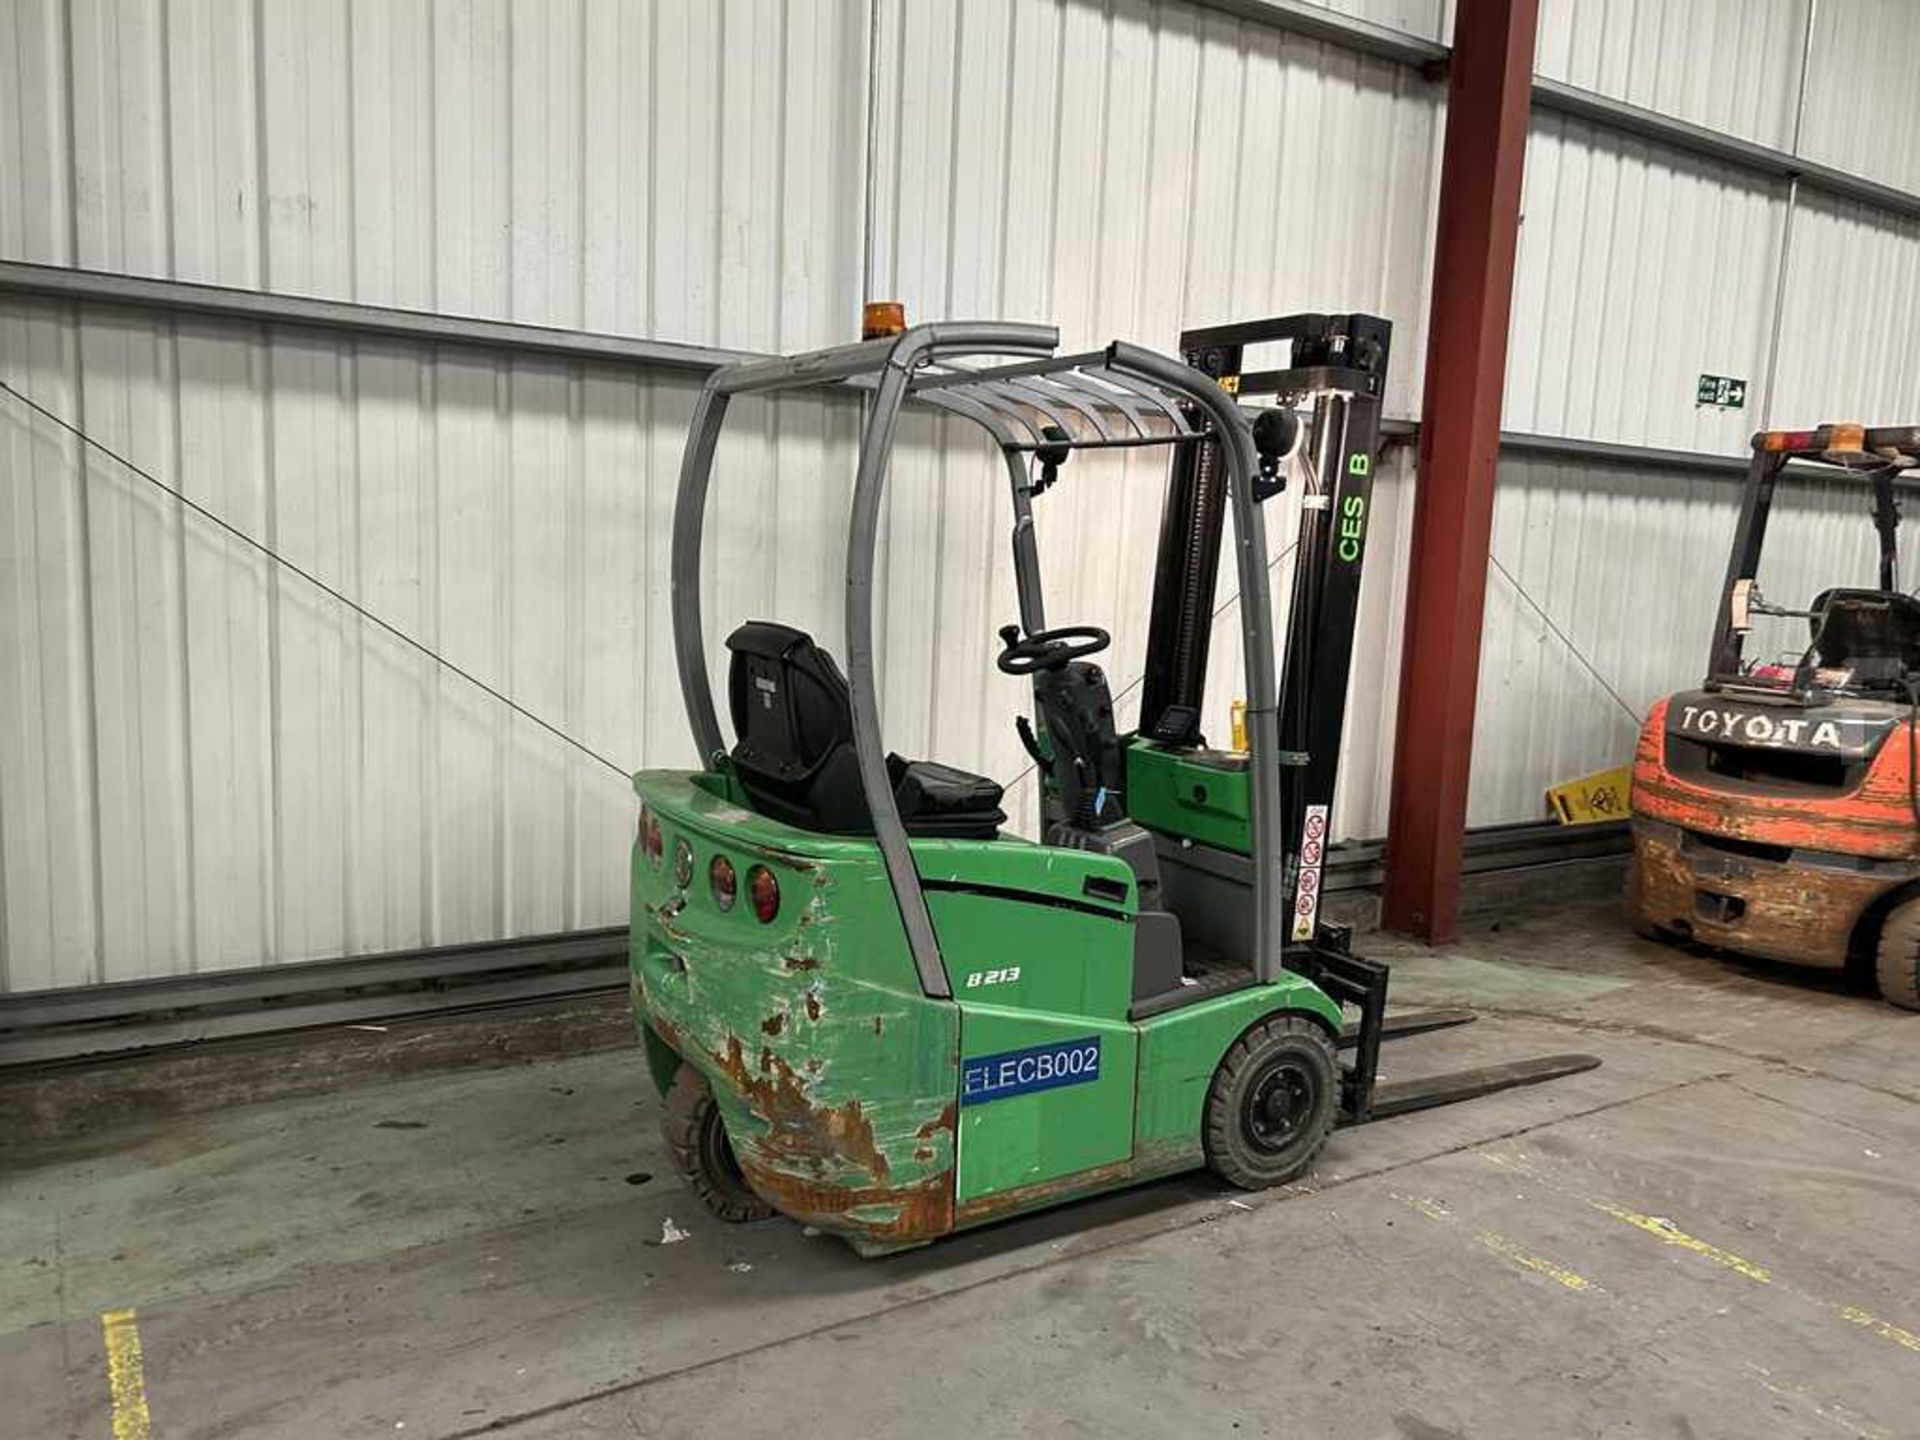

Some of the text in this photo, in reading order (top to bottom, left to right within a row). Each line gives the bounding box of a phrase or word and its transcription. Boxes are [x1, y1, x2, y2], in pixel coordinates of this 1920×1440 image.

[1339, 453, 1370, 562] CES B
[1682, 706, 1841, 748] TOYOTA
[984, 966, 1021, 985] 213
[965, 1047, 1098, 1094] ELECB002
